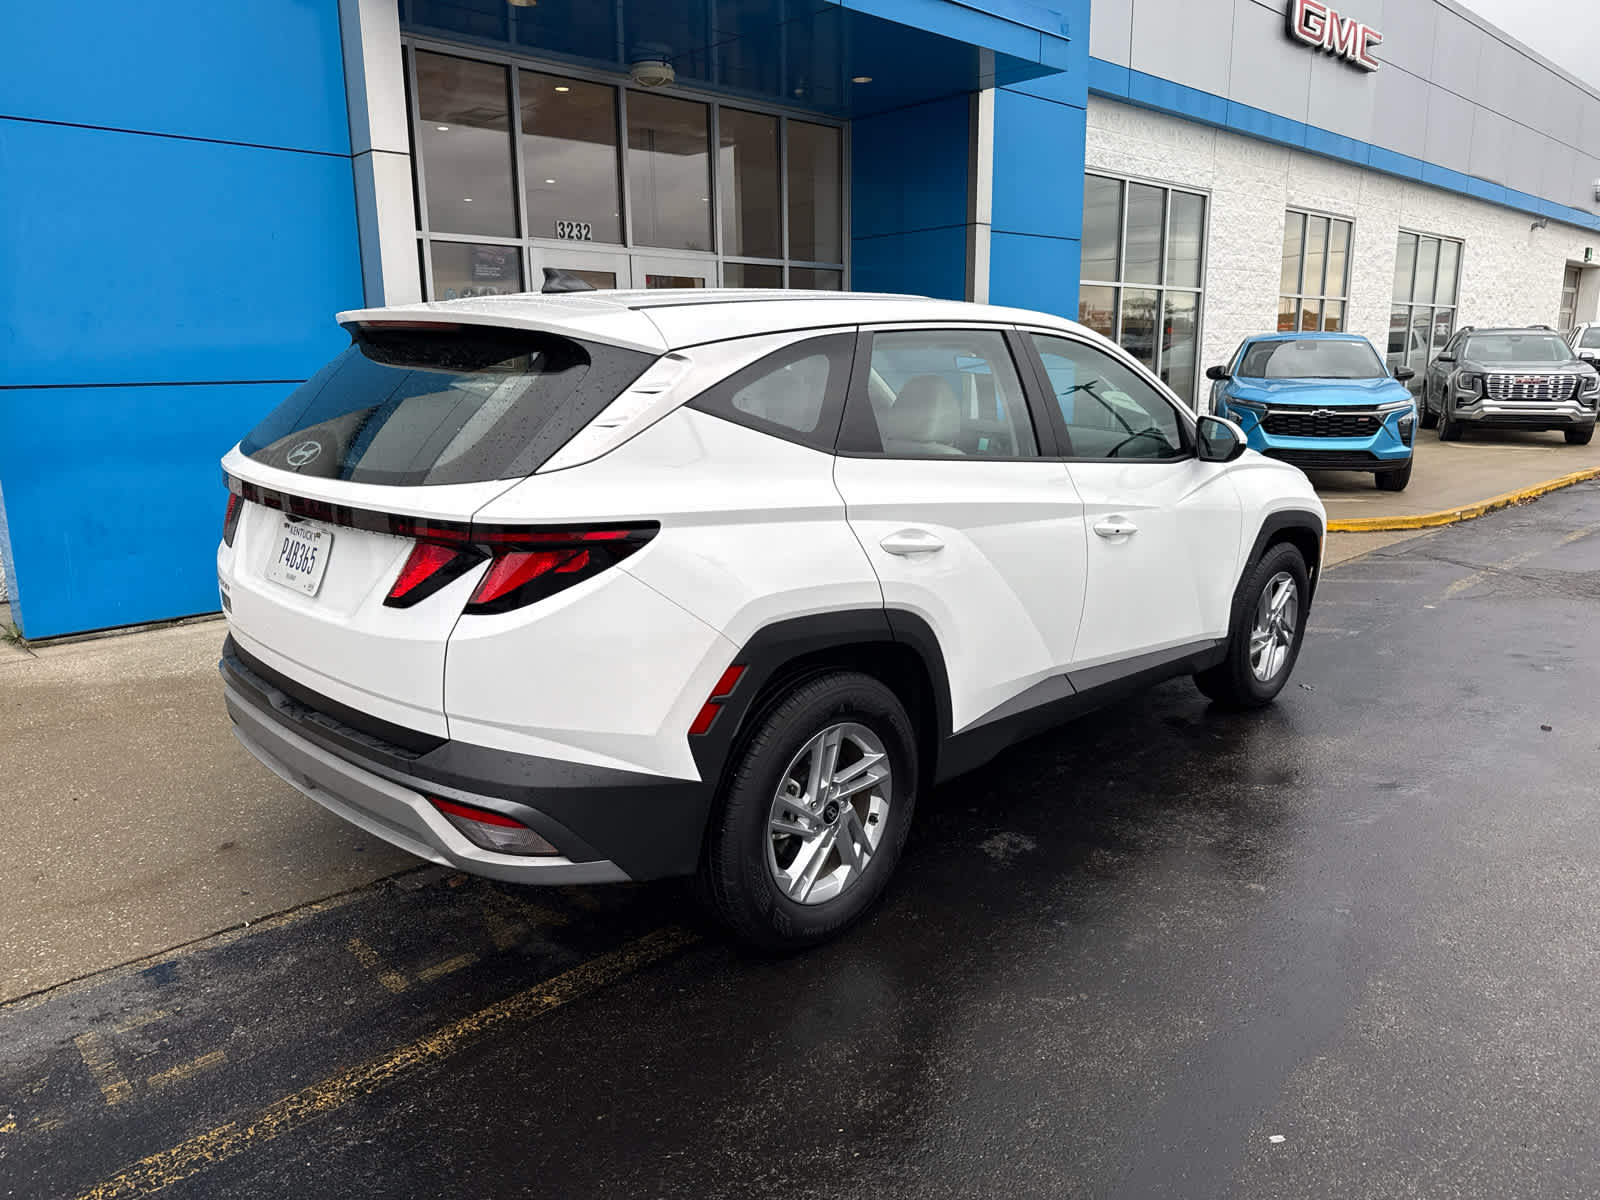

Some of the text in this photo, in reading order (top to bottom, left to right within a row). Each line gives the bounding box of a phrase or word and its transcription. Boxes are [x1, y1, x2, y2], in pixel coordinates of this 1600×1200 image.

[1293, 0, 1383, 72] GMC
[558, 221, 592, 241] 3232
[289, 525, 317, 541] KENTUCKY
[278, 537, 318, 575] P4B365
